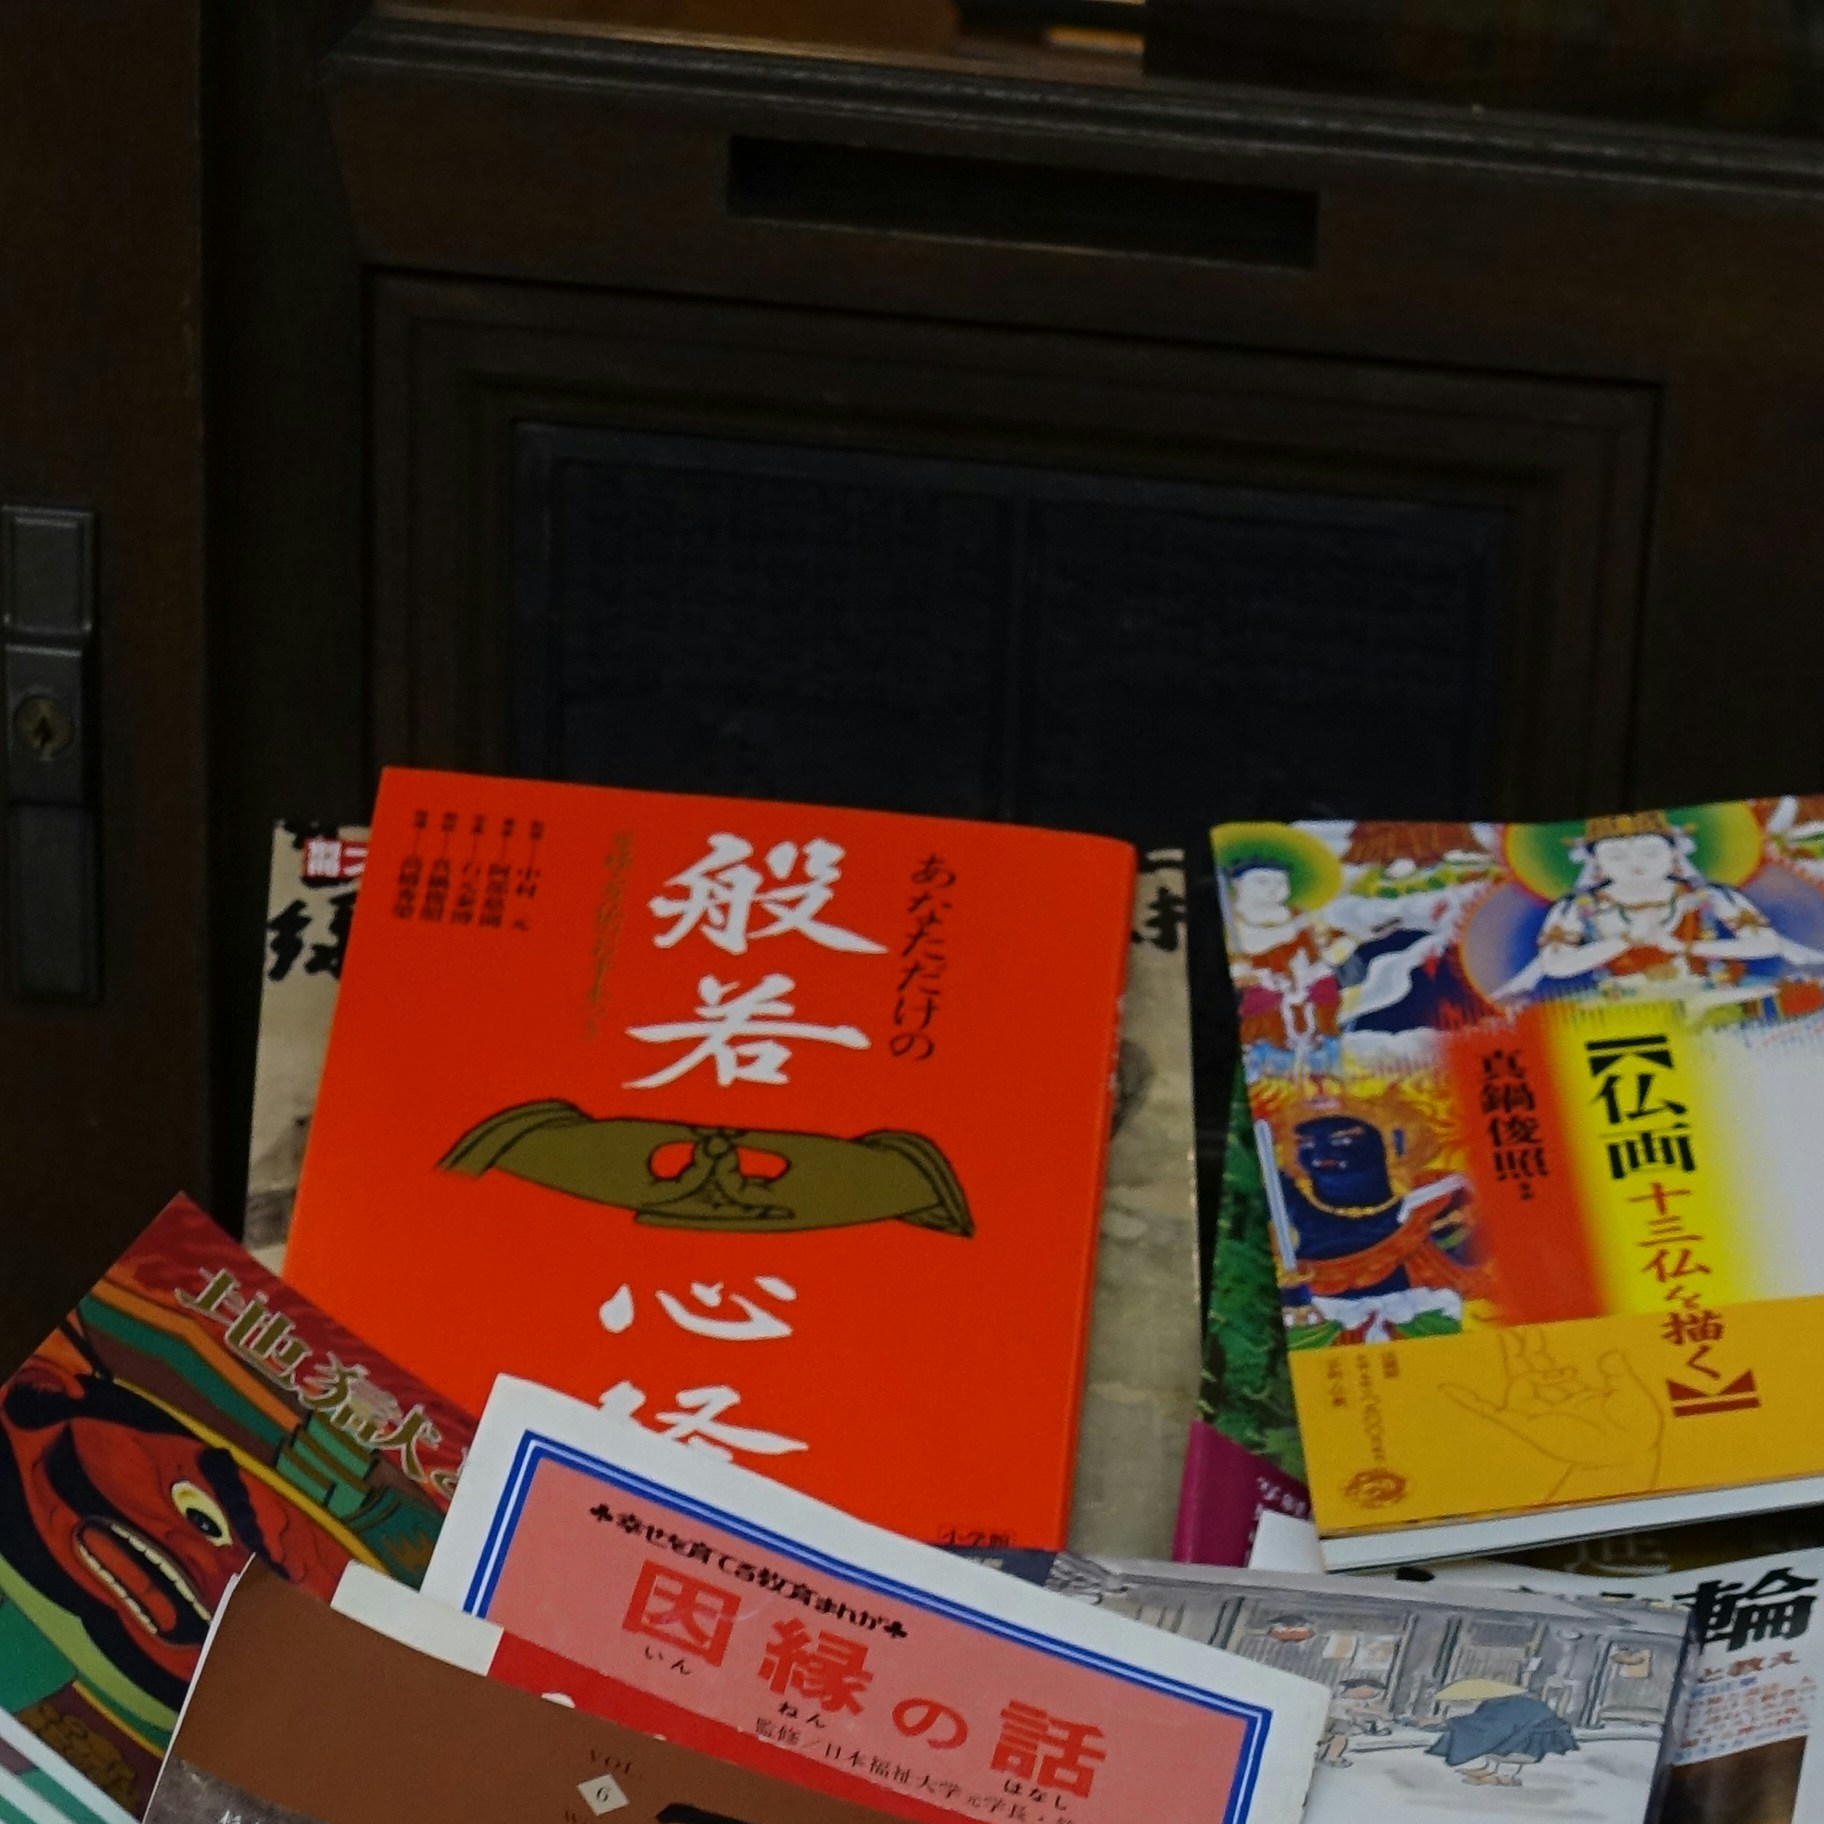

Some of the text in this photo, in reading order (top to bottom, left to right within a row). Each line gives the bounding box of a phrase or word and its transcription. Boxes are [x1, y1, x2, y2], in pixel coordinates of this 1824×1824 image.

[888, 852, 958, 1061] あなただけの
[1474, 1045, 1555, 1183] 真鍋俊照
[613, 1511, 891, 1633] 幸せを育てる教育まんが
[621, 1559, 1108, 1798] 因縁の話
[643, 1645, 694, 1678] いん
[777, 1701, 827, 1730] ねん
[593, 1783, 612, 1804] 6
[1001, 1776, 1069, 1813] はなし
